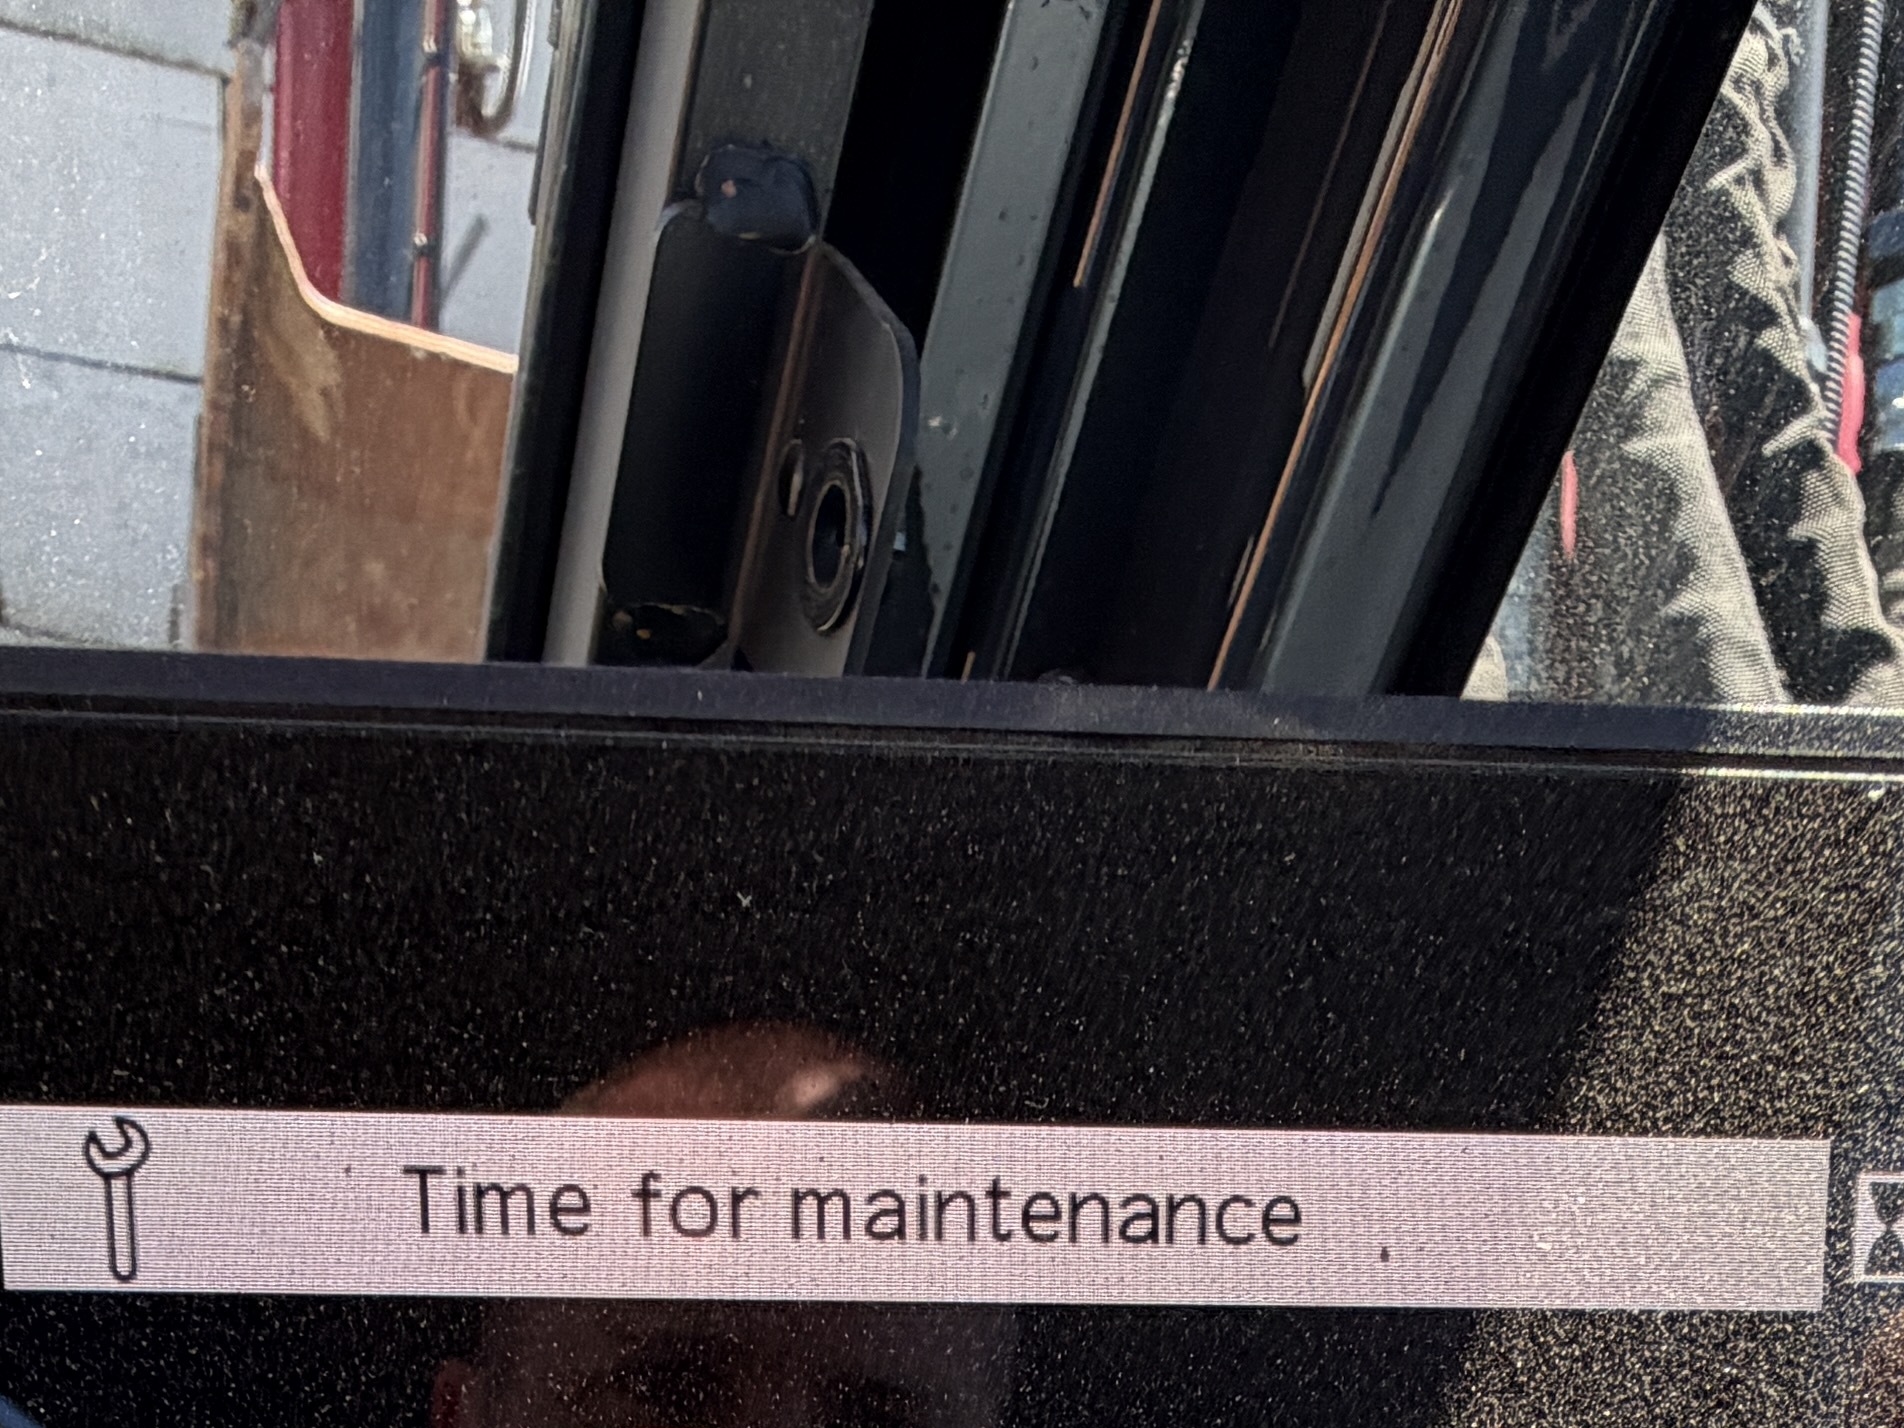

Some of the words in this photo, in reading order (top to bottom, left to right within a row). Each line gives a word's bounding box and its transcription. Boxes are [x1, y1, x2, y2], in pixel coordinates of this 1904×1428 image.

[403, 1164, 592, 1238] Time
[631, 1170, 763, 1240] for
[789, 1176, 1303, 1249] maintenance
